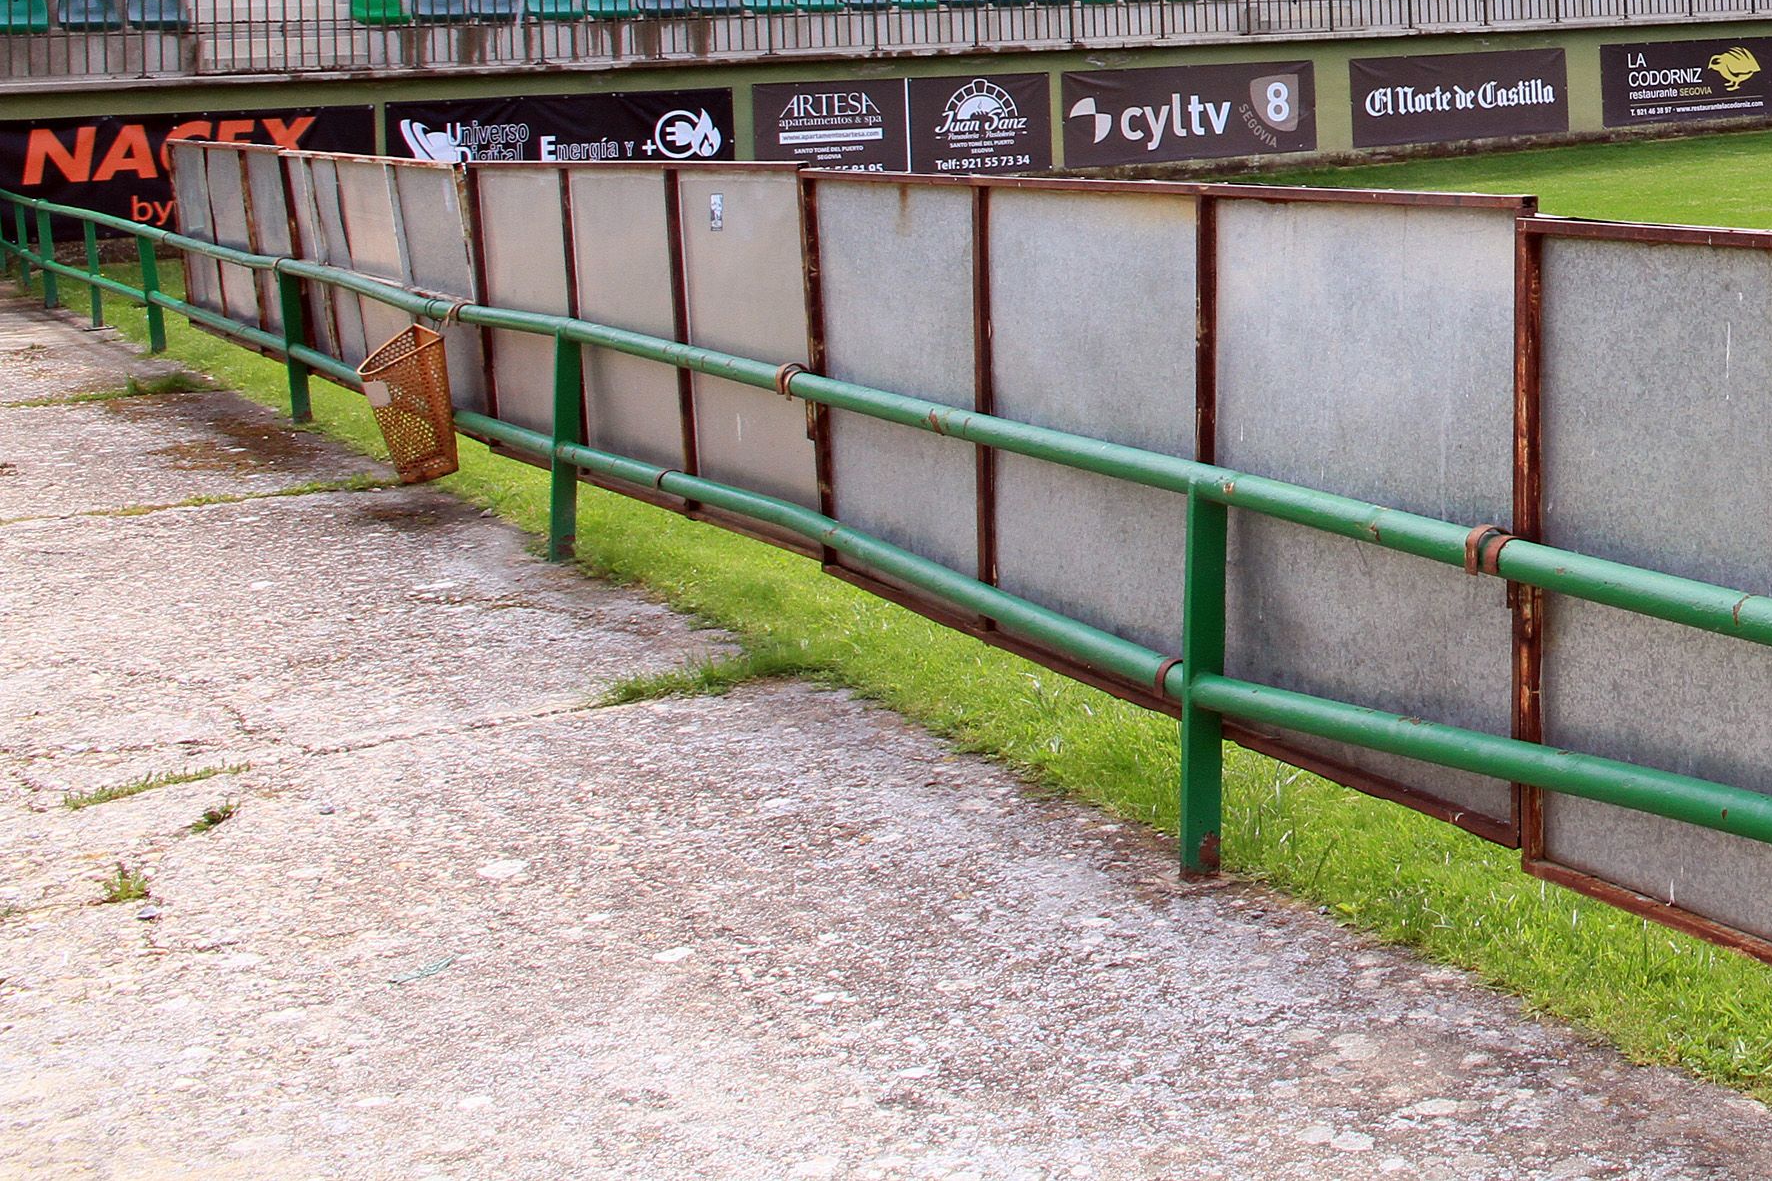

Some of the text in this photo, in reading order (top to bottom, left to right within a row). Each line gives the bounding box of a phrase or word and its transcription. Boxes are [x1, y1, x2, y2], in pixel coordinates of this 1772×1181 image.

[1627, 52, 1647, 69] LA
[1628, 67, 1703, 87] CODORNIZ
[1266, 81, 1289, 122] 8
[1365, 78, 1556, 118] El Norte de Castilla
[1629, 86, 1713, 100] restaurante SEGOVIA
[779, 92, 881, 118] ARTESA
[1636, 107, 1648, 116] 921
[778, 114, 882, 130] apartamentos & spa
[934, 108, 1028, 133] Juan Sanz
[1120, 93, 1232, 151] cyltv
[1238, 102, 1279, 149] SEGOVIA
[446, 120, 530, 146] Universo
[540, 136, 620, 161] Energía
[816, 153, 842, 161] SEGOVIA
[970, 147, 995, 155] SEGOVIA
[935, 154, 1031, 171] Telf: 921 55 73 34
